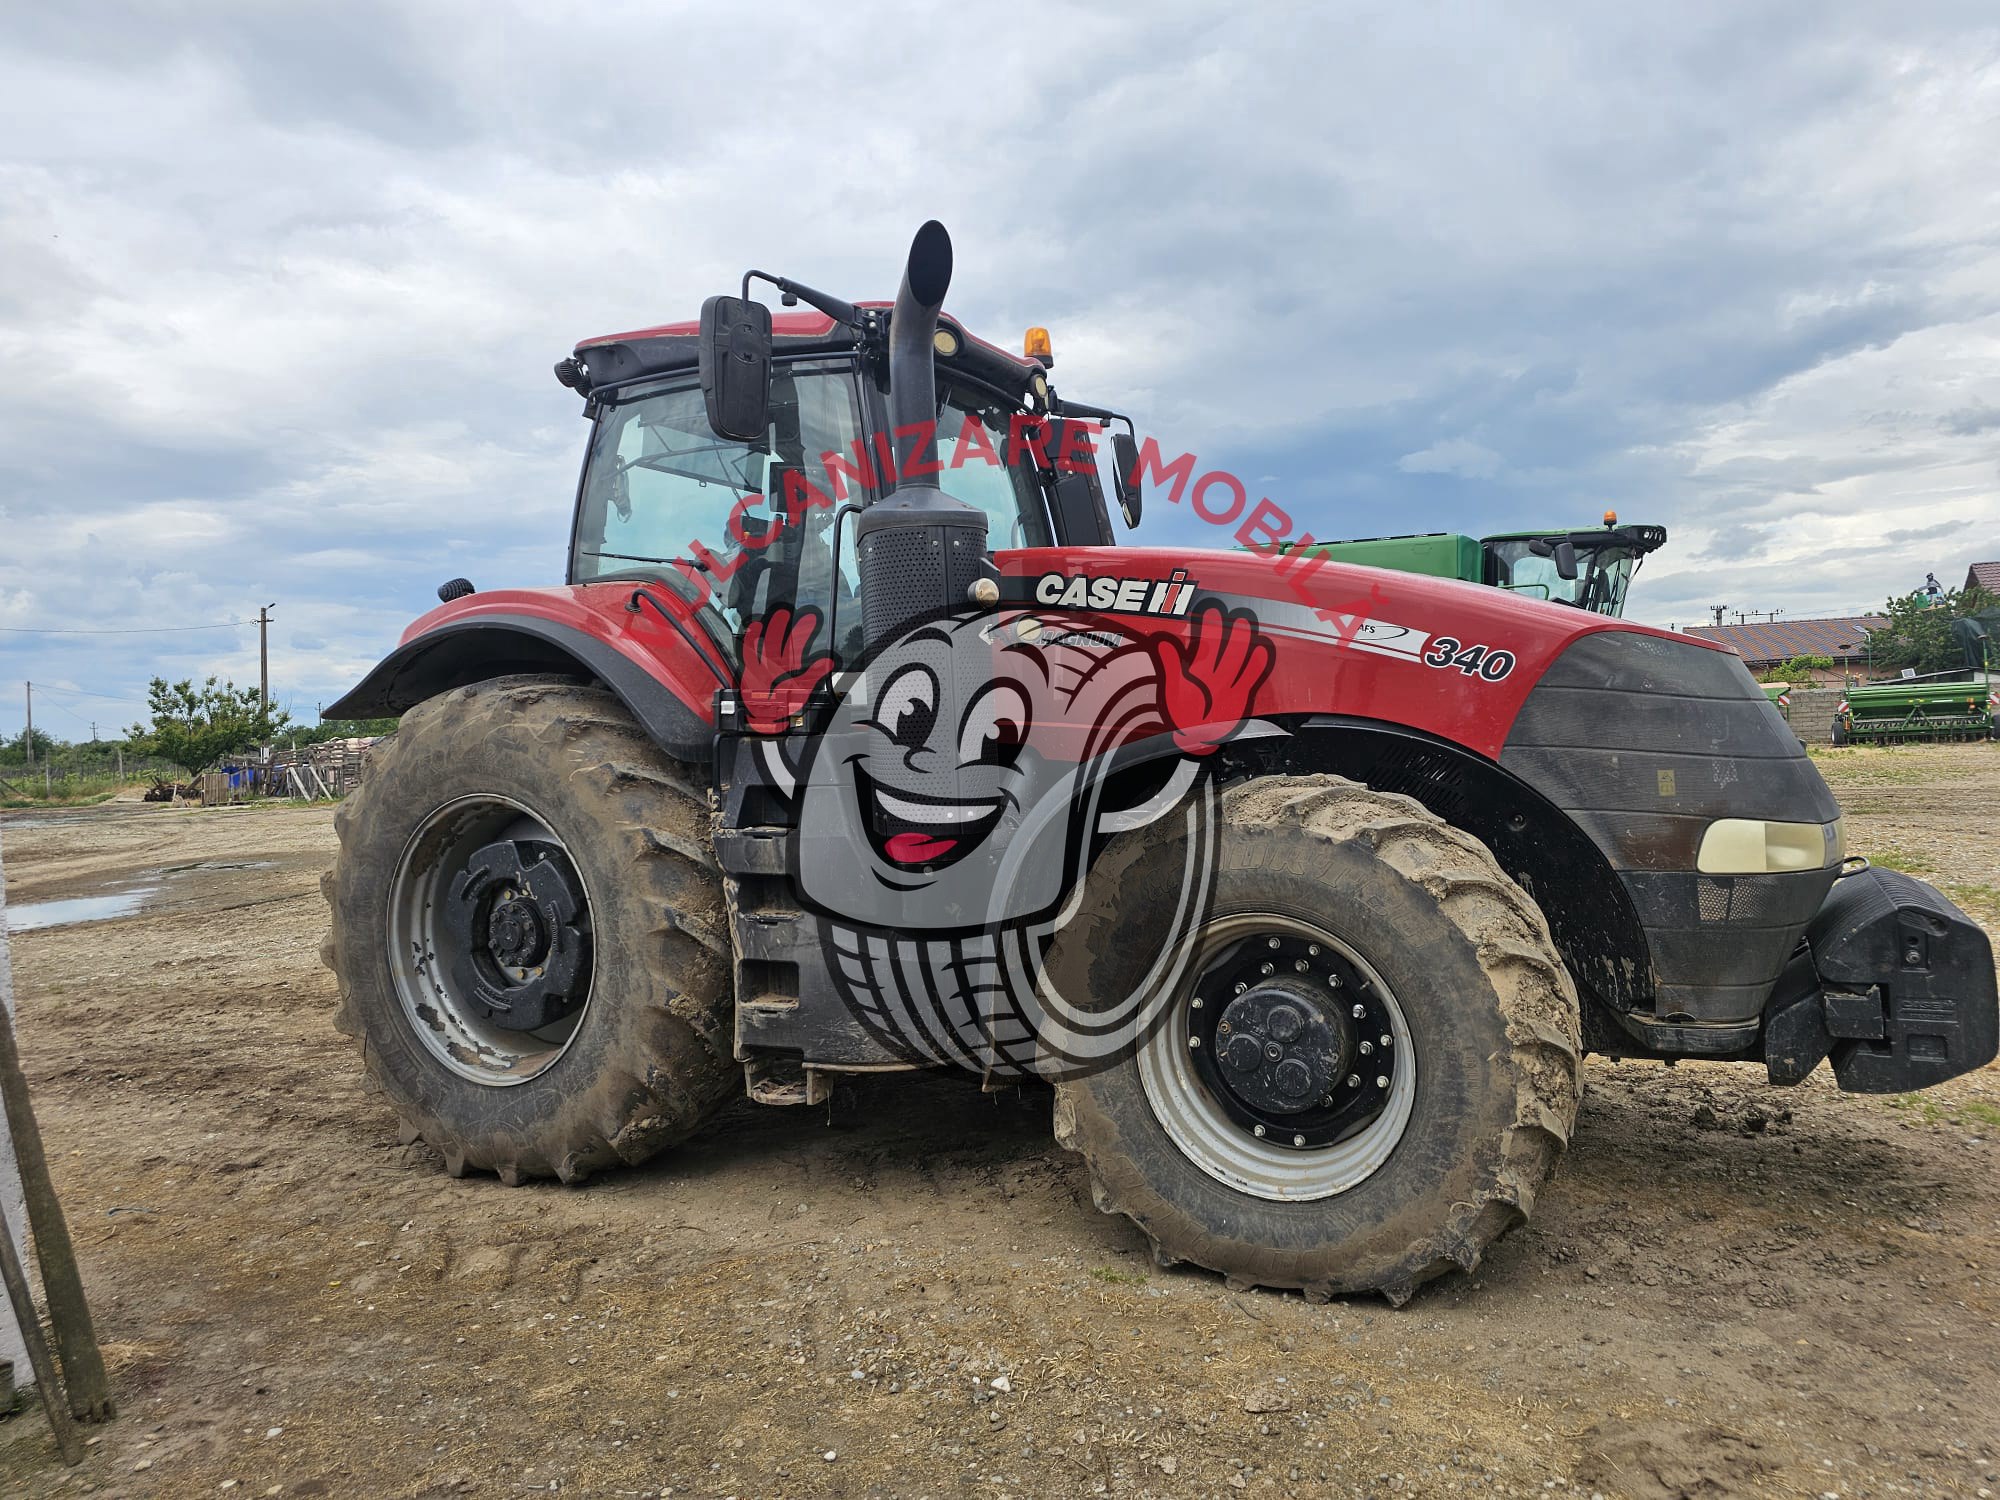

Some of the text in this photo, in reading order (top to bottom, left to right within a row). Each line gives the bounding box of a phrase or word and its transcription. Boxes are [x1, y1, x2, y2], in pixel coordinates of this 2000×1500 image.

[1036, 574, 1149, 612] CASE
[1357, 623, 1376, 634] AFS
[1424, 636, 1516, 683] 340
